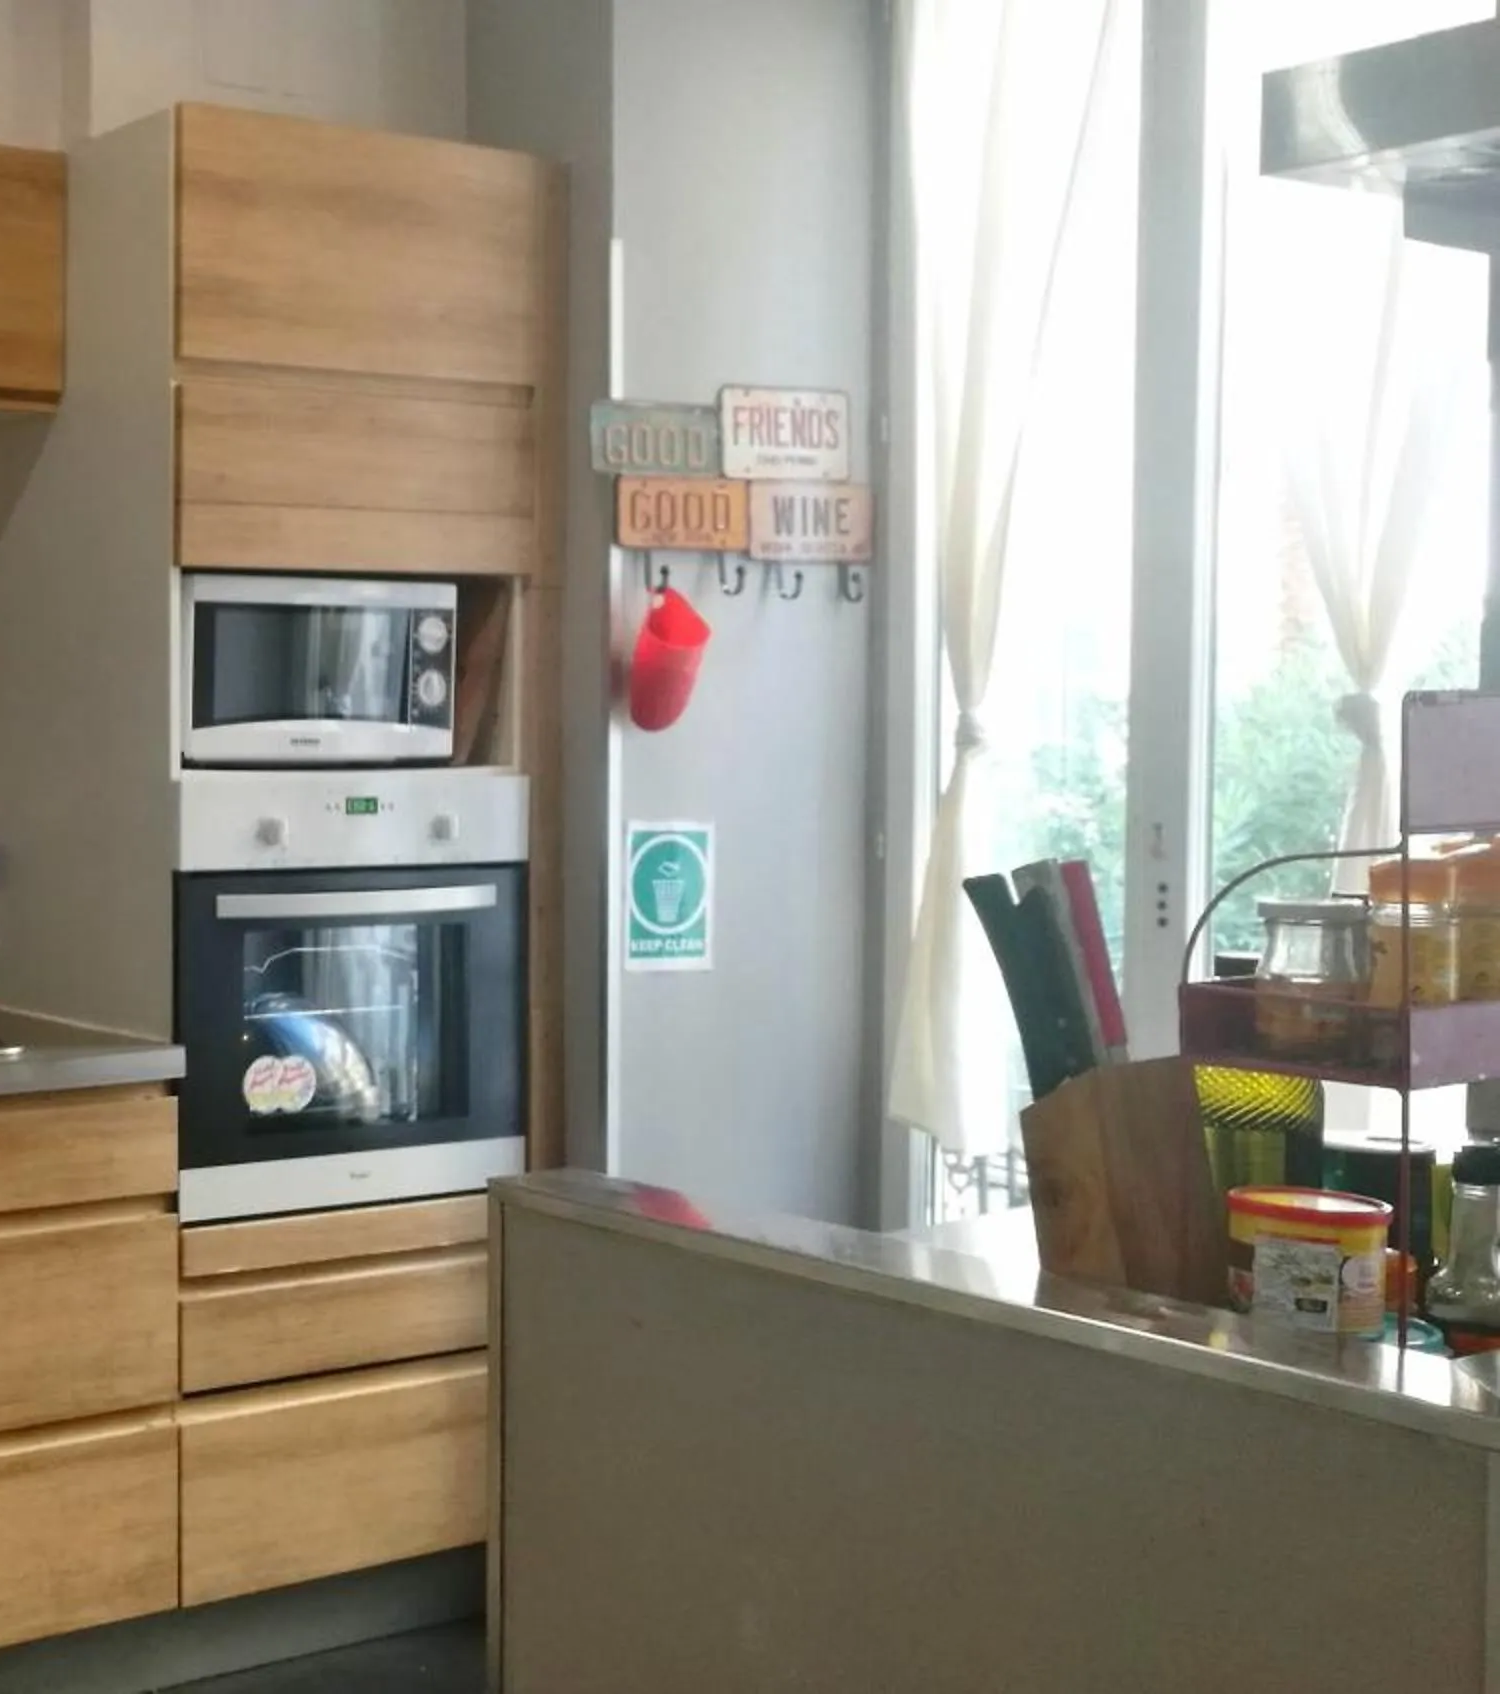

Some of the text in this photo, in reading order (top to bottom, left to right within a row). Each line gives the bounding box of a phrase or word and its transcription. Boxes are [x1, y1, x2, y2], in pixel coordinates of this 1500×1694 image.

[606, 424, 704, 467] GOOD
[731, 404, 841, 450] FRIENDS
[629, 489, 731, 533] GOOD
[772, 495, 851, 537] WINE
